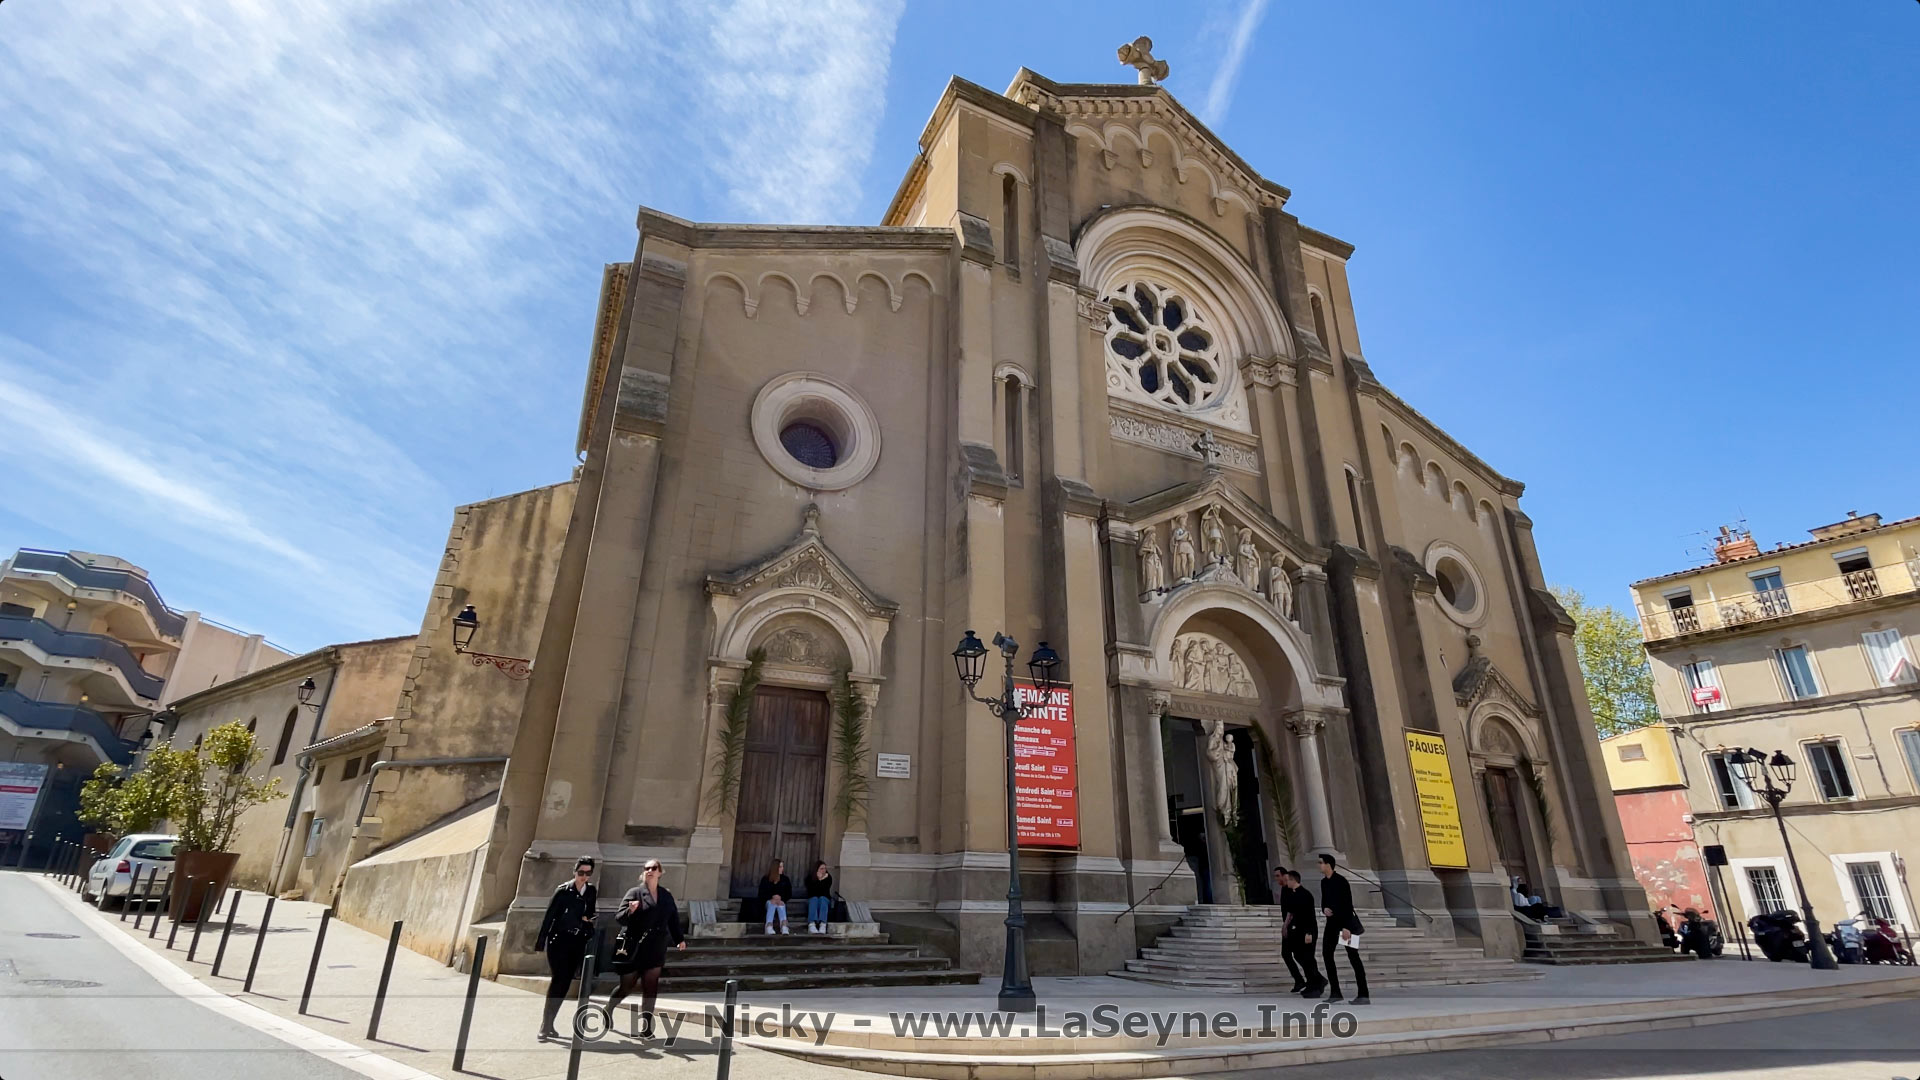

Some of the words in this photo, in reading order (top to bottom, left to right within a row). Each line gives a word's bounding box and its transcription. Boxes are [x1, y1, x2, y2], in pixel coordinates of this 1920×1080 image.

[1014, 688, 1070, 706] EMAINE
[1015, 786, 1039, 795] Vendredi
[1041, 787, 1055, 795] Saint
[1016, 815, 1035, 823] Samedi
[1037, 816, 1051, 824] Saint
